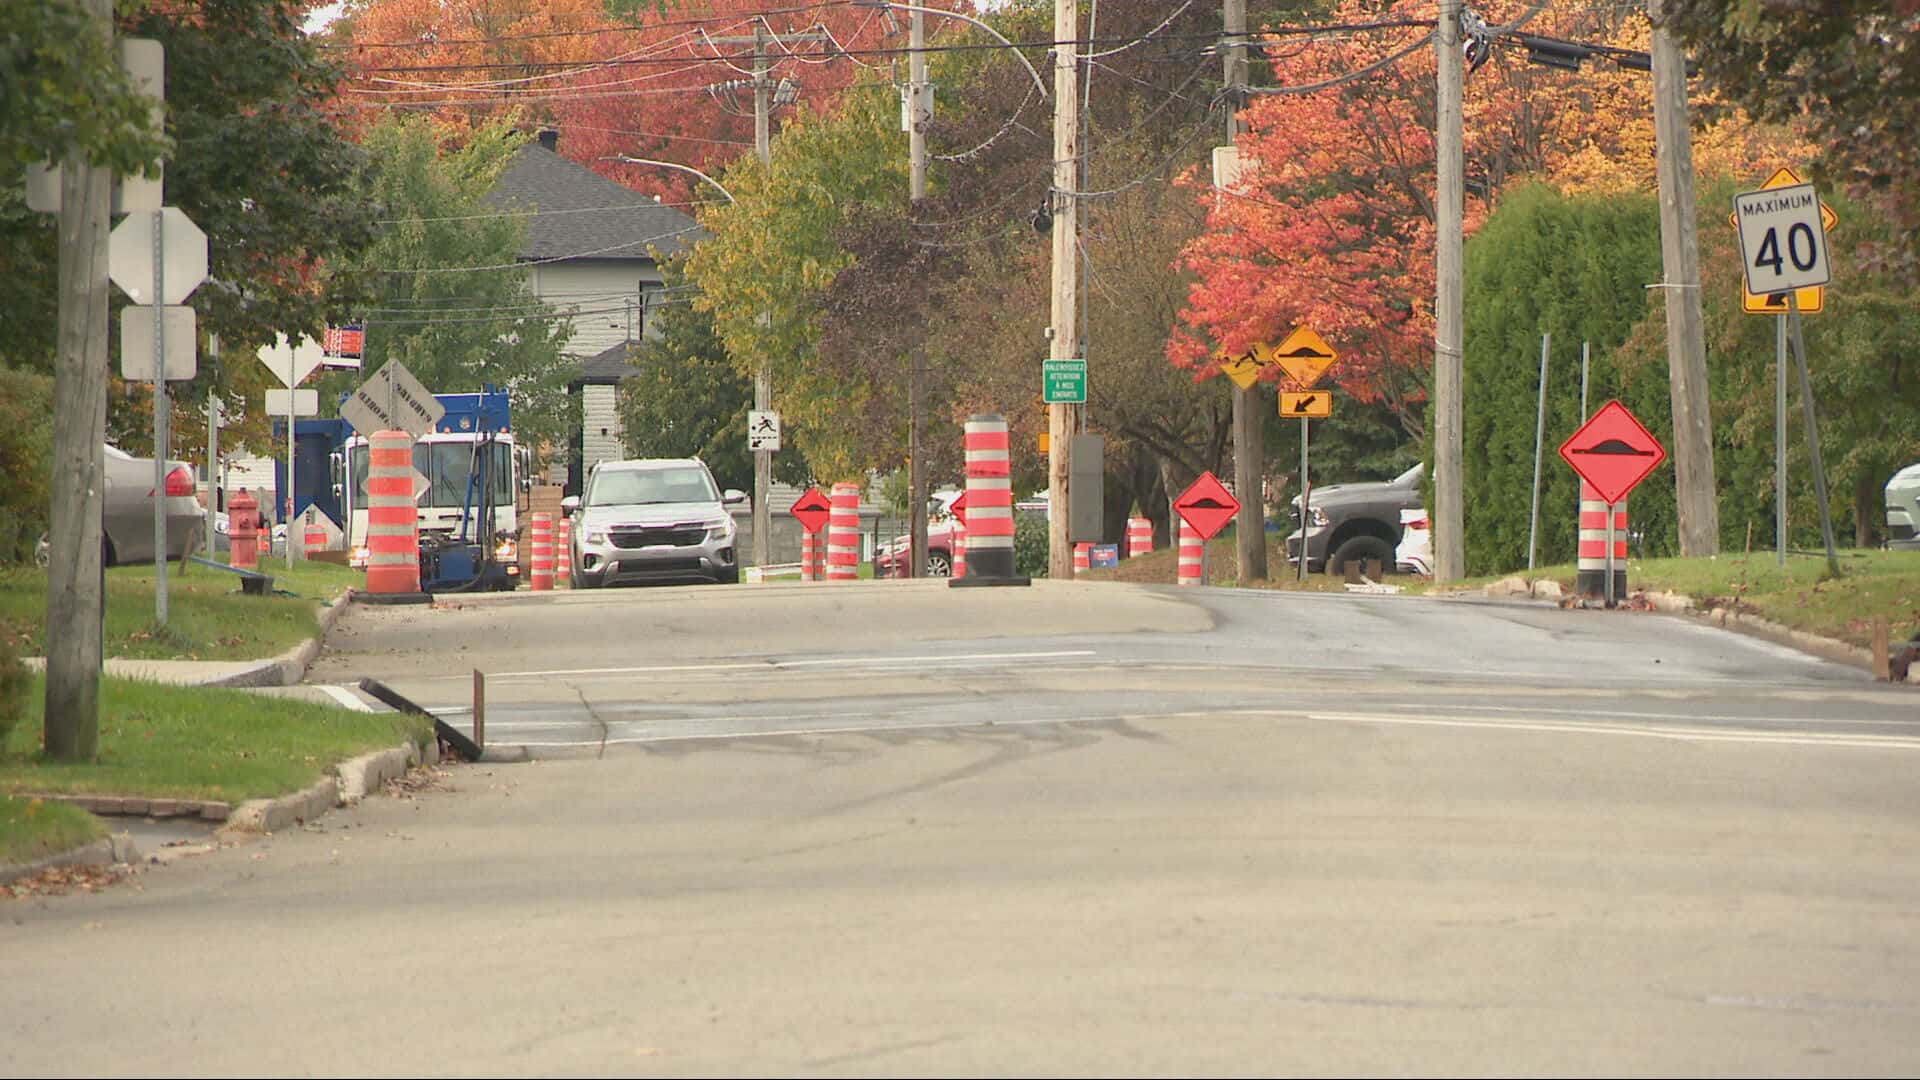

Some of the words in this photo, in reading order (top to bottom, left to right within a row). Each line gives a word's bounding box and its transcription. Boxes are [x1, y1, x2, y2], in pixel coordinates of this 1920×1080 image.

[1743, 194, 1813, 216] MAXIMUM
[1754, 222, 1817, 276] 40
[1050, 372, 1081, 380] ATTENTION
[1062, 381, 1075, 389] NOS
